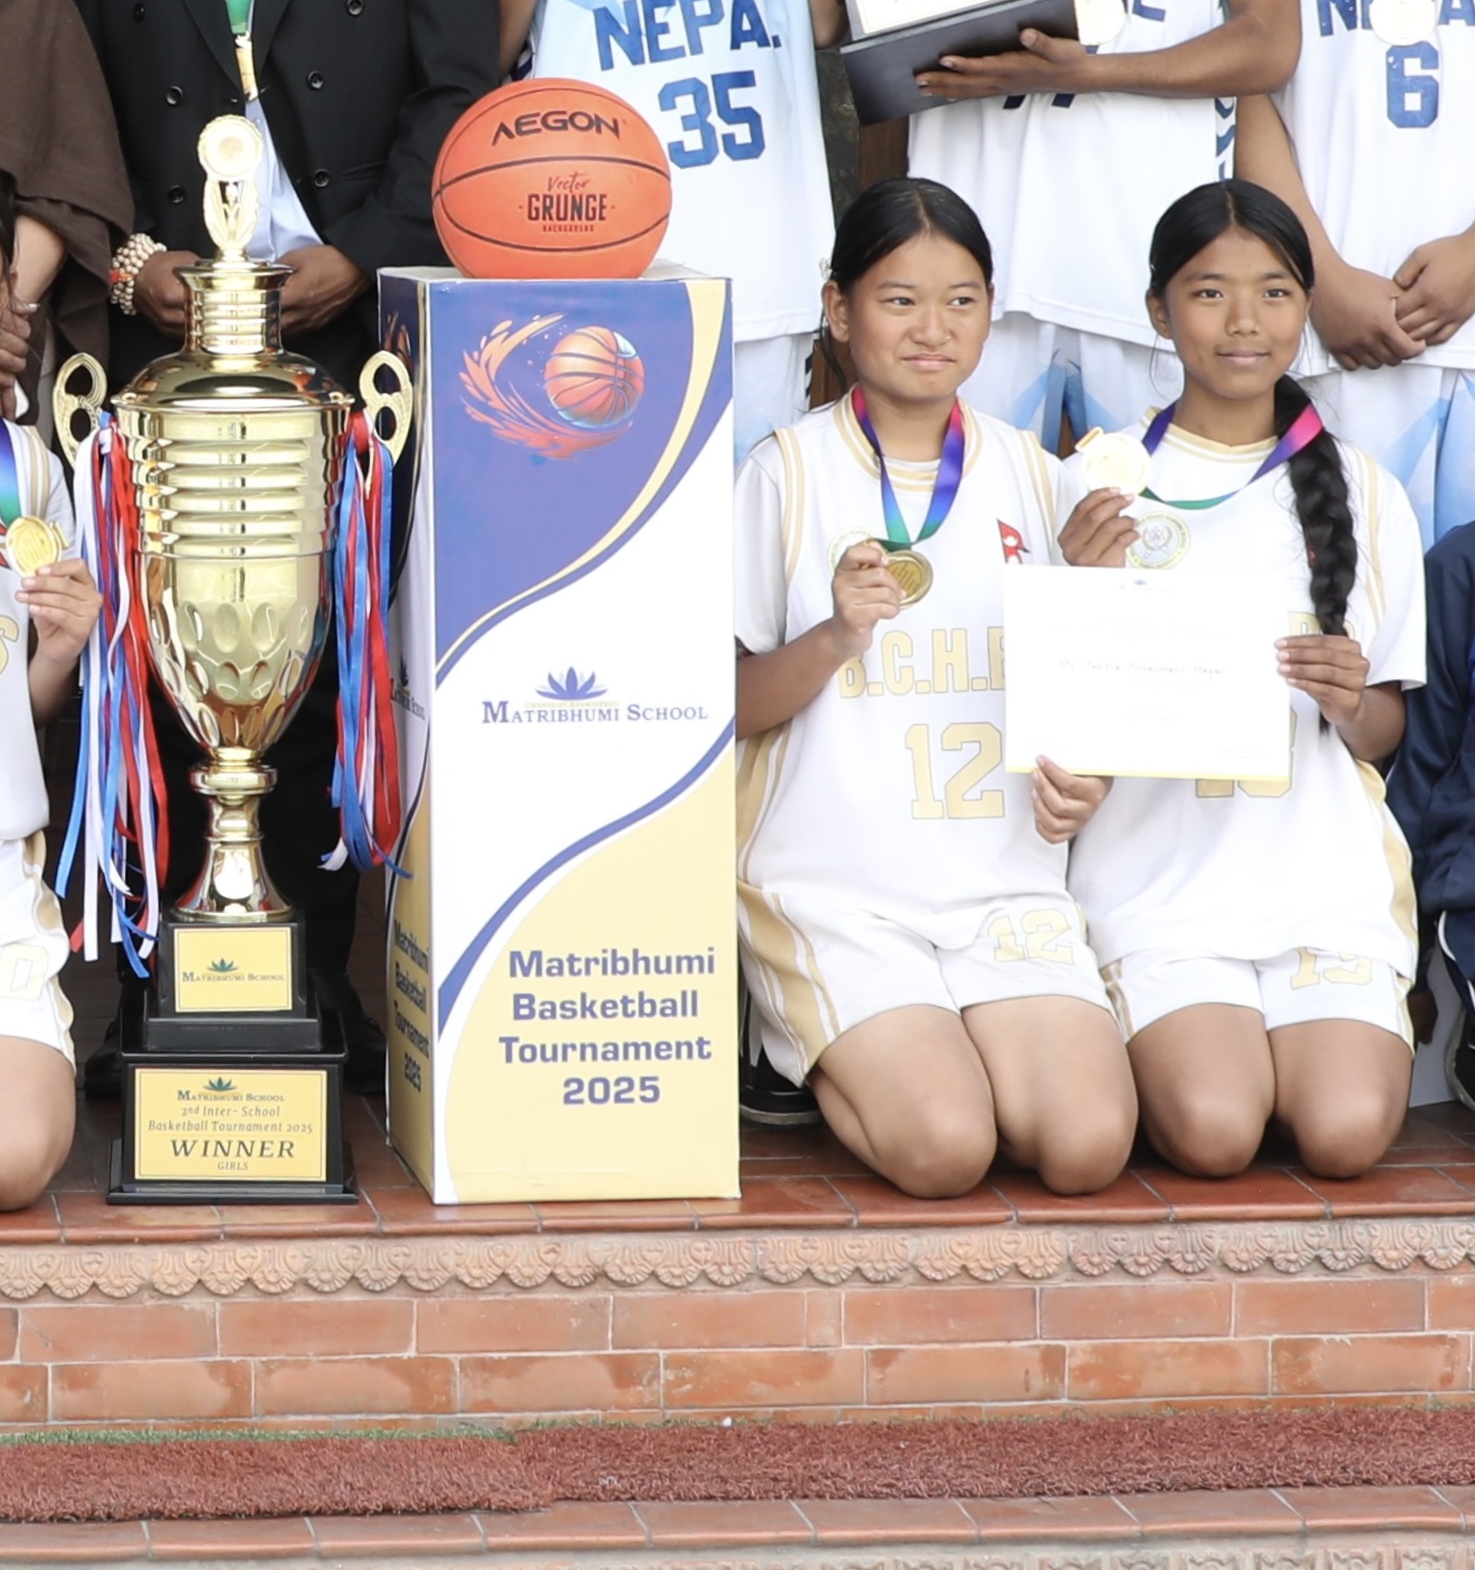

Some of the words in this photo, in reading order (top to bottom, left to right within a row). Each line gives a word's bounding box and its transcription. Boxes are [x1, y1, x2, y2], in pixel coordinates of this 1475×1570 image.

[1385, 42, 1439, 130] 6
[492, 111, 620, 146] AEGON
[657, 70, 767, 170] 35
[547, 171, 591, 194] Vector
[527, 193, 608, 222] GRUNGE
[542, 224, 595, 233] BACKGROUND
[481, 701, 620, 724] MATRIBHUMI
[626, 704, 709, 722] SCHOOL
[904, 723, 1005, 820] 12
[987, 908, 1076, 966] 12
[247, 973, 285, 981] SCHOOL
[509, 946, 716, 980] Matribhumi
[512, 990, 699, 1022] Basketball
[499, 1035, 712, 1065] Tournament
[177, 1089, 243, 1102] MATRIBHUMI
[246, 1092, 285, 1102] SCHOOL
[562, 1075, 662, 1107] 2025
[181, 1106, 200, 1117] 2nd
[241, 1106, 280, 1117] School
[148, 1120, 208, 1132] Basketball
[212, 1121, 283, 1132] Tournament
[286, 1123, 313, 1134] 2025
[171, 1139, 295, 1159] WINNER
[217, 1161, 249, 1171] GIRLS
